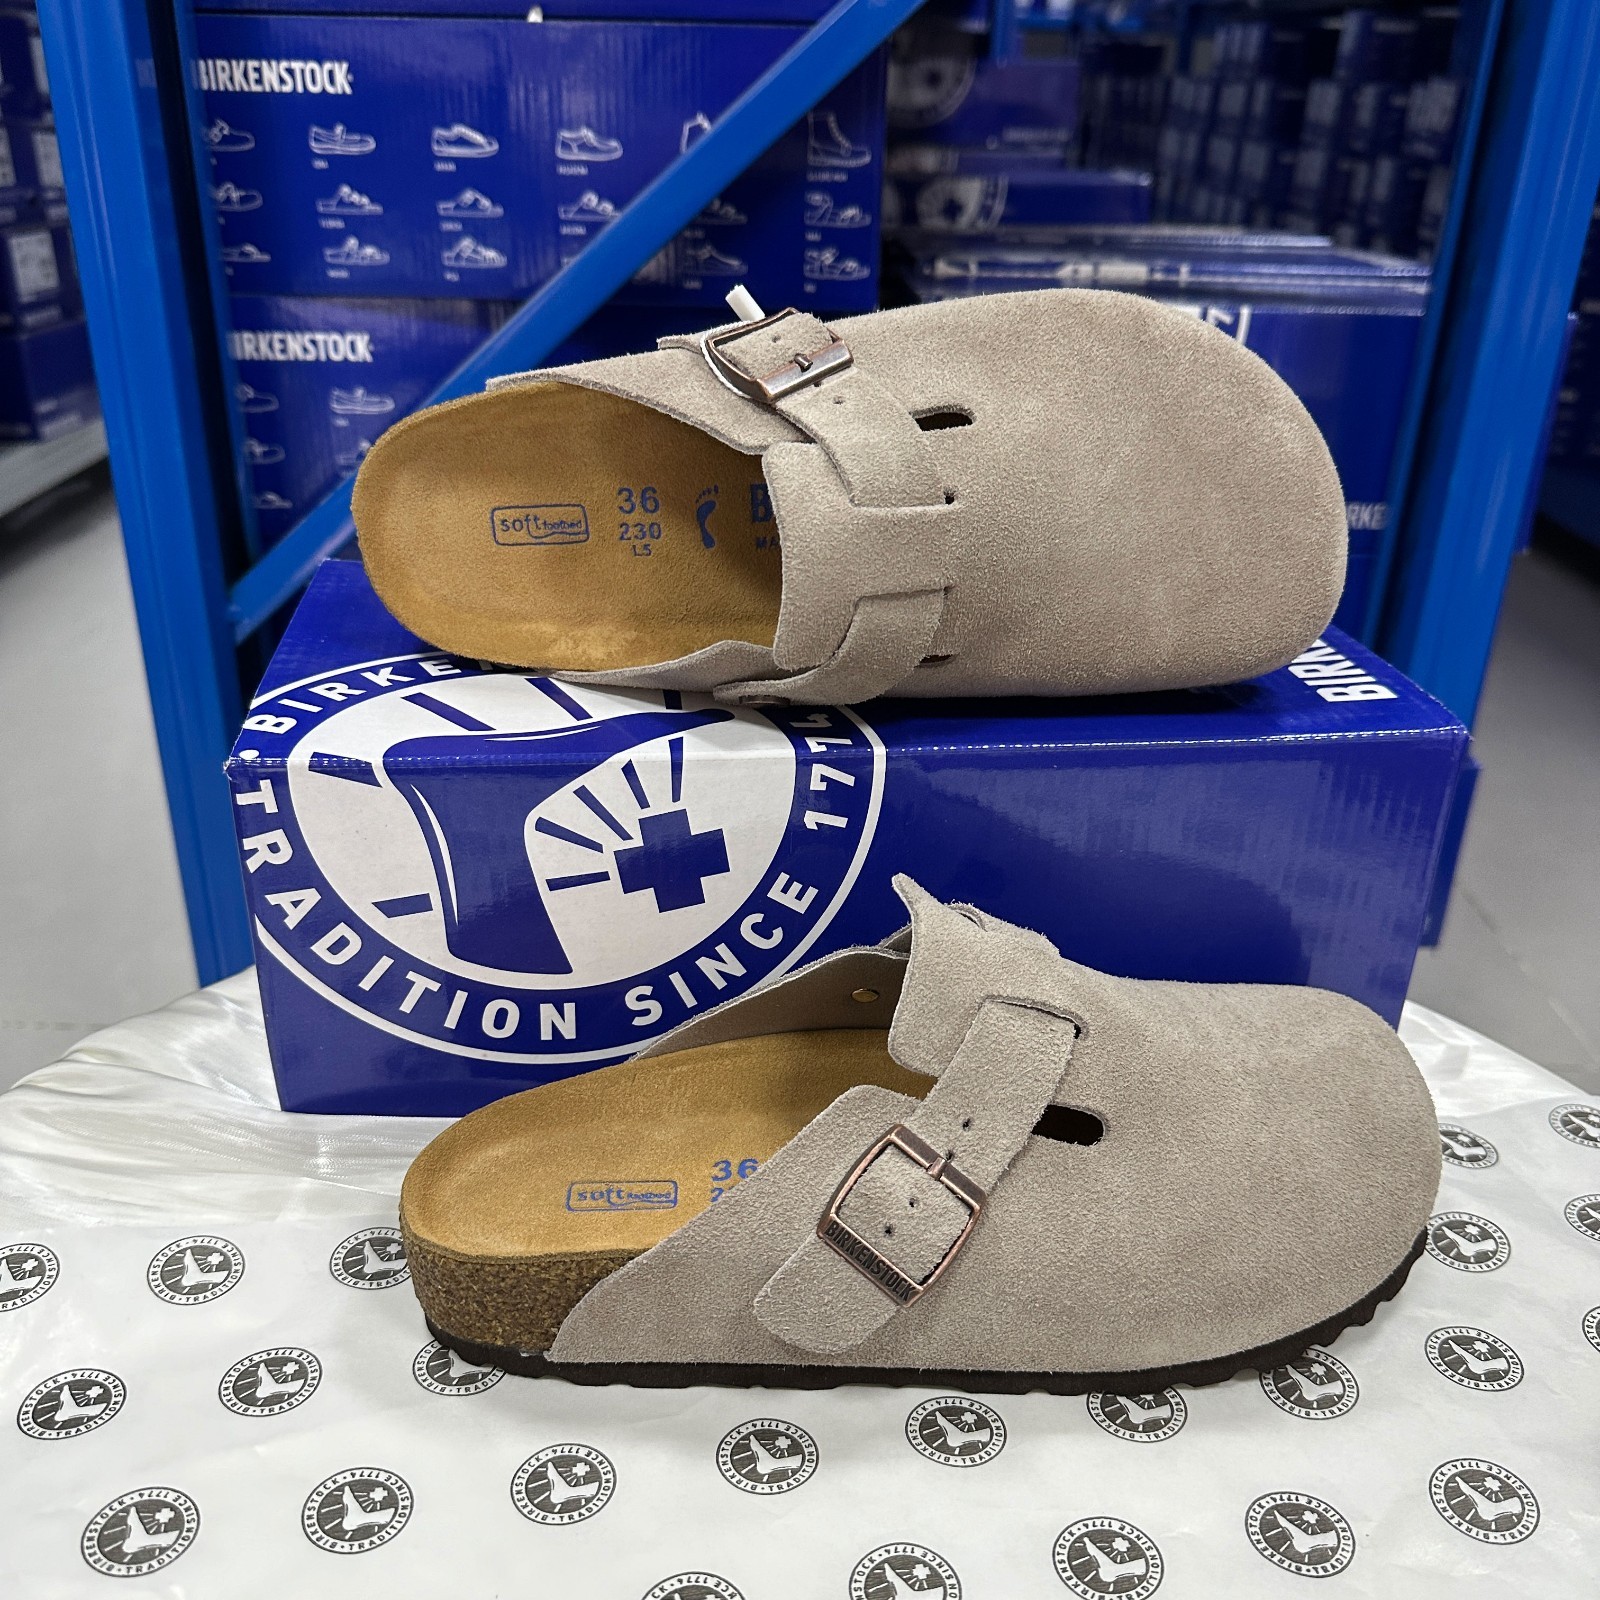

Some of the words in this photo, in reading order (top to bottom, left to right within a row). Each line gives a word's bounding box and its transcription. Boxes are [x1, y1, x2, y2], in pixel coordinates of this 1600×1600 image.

[231, 330, 373, 362] IRKENSTOCK
[617, 486, 660, 514] 36
[619, 522, 662, 541] 230
[235, 779, 578, 1041] TRADITION
[624, 872, 820, 1028] SINCE
[789, 713, 856, 831] 1774
[711, 1158, 760, 1181] 36
[825, 1220, 917, 1301] BIRKENSTOCK
[1, 1273, 55, 1310] RADITION
[368, 1269, 411, 1288] TRADIT
[416, 1343, 447, 1393] BIRKENSTOC
[934, 1398, 963, 1406] 1774
[967, 1401, 1000, 1424] SINCE
[1089, 1393, 1136, 1440] BIRKENSTO
[750, 1421, 780, 1430] 1774
[783, 1424, 814, 1449] SINCE
[908, 1405, 951, 1463] BIRKENSTOCK
[551, 1446, 581, 1456] 1774
[719, 1428, 758, 1491] BIRKENSTOCK
[960, 1425, 1004, 1464] TRADITION
[349, 1469, 381, 1479] 1774
[584, 1449, 612, 1476] SINCE
[767, 1450, 815, 1492] TRADITION
[1450, 1460, 1481, 1470] 1774
[1486, 1463, 1526, 1492] SINCE
[383, 1474, 410, 1503] SINCE
[514, 1454, 549, 1522] BIRKENSTOCK
[558, 1477, 612, 1523] TRADITION
[305, 1477, 340, 1549] BIRKENSTOCK
[1432, 1469, 1491, 1540] BIRKENSTOCK
[1499, 1493, 1536, 1541] TRADITION
[348, 1504, 410, 1551] TRADITION
[1081, 1520, 1113, 1530] 1774
[1118, 1523, 1155, 1552] SINCE
[883, 1546, 915, 1556] 1774
[920, 1550, 955, 1581] SINCE
[676, 1575, 708, 1586] 1774
[853, 1555, 877, 1600] NSTOCK
